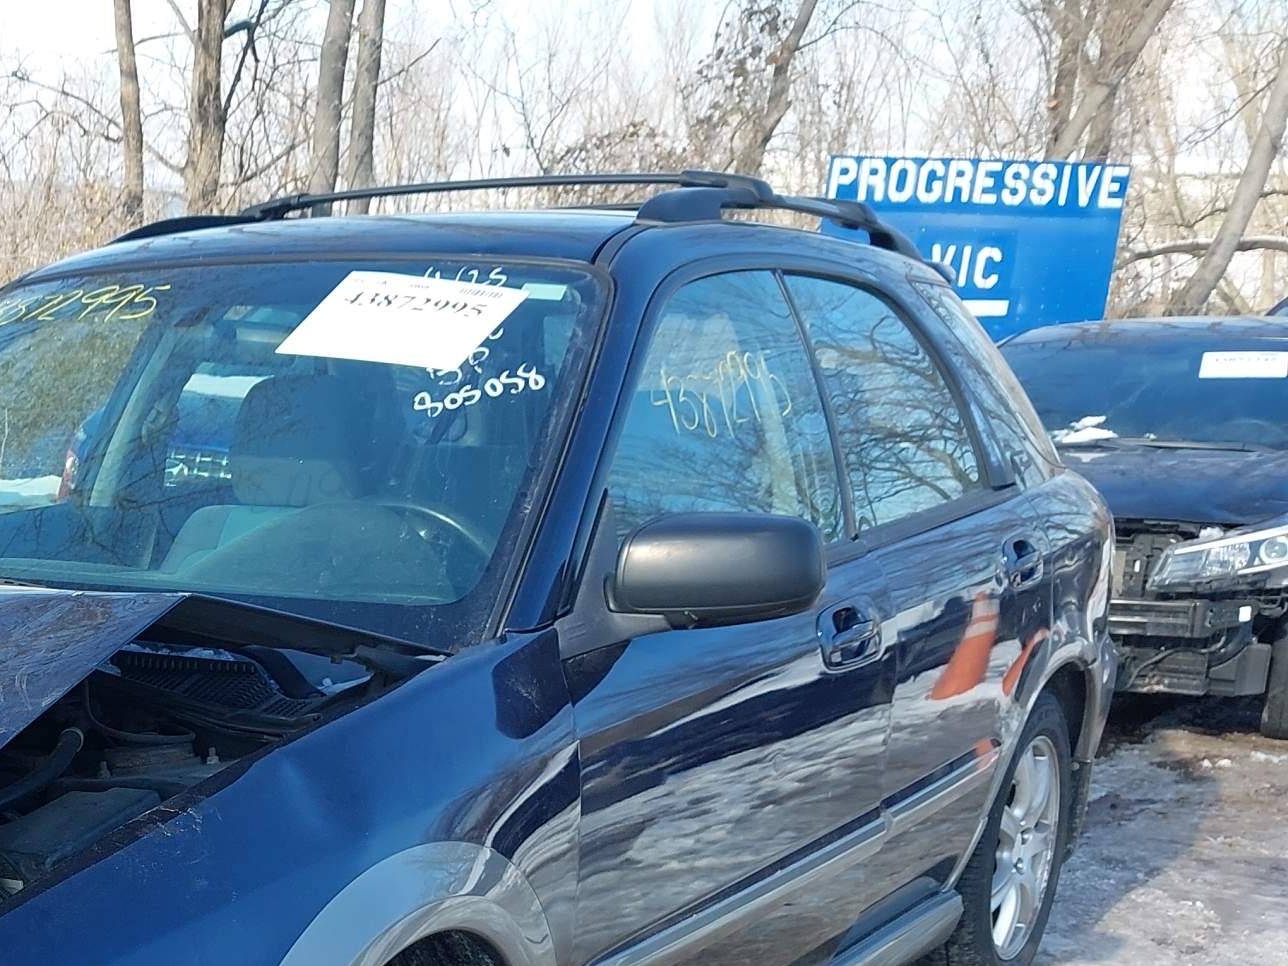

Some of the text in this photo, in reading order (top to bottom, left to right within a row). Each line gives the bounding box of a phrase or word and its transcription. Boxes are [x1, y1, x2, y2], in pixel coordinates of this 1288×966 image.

[828, 157, 1129, 209] PROGRESSIVE
[345, 291, 487, 318] 43872995
[413, 362, 546, 418] 805058
